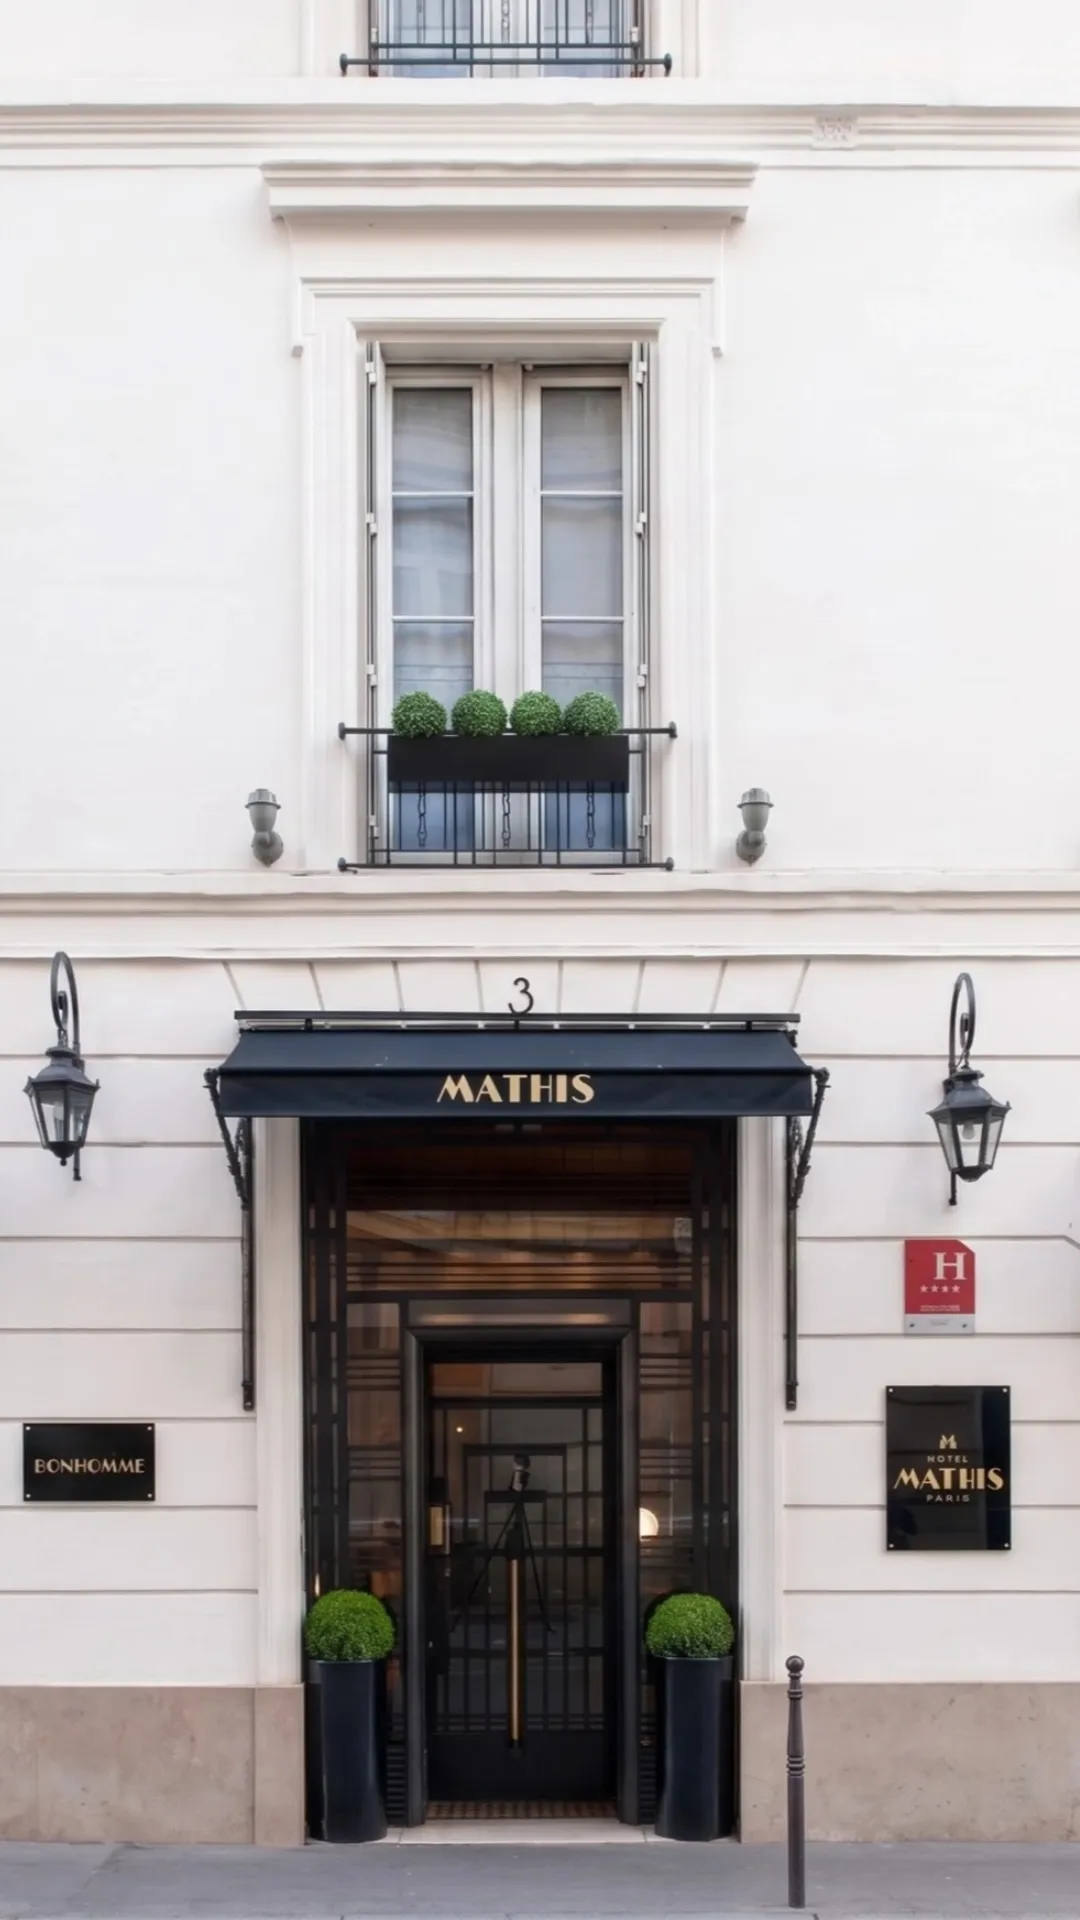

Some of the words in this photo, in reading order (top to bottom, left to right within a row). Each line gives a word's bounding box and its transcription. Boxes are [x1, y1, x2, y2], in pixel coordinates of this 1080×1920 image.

[508, 977, 534, 1015] 3
[436, 1074, 594, 1104] MATHIS
[932, 1252, 967, 1280] H
[34, 1458, 145, 1474] BONHOMME
[927, 1455, 969, 1463] HOTEL
[893, 1467, 1004, 1490] MATHIS
[926, 1494, 970, 1502] PARIS
